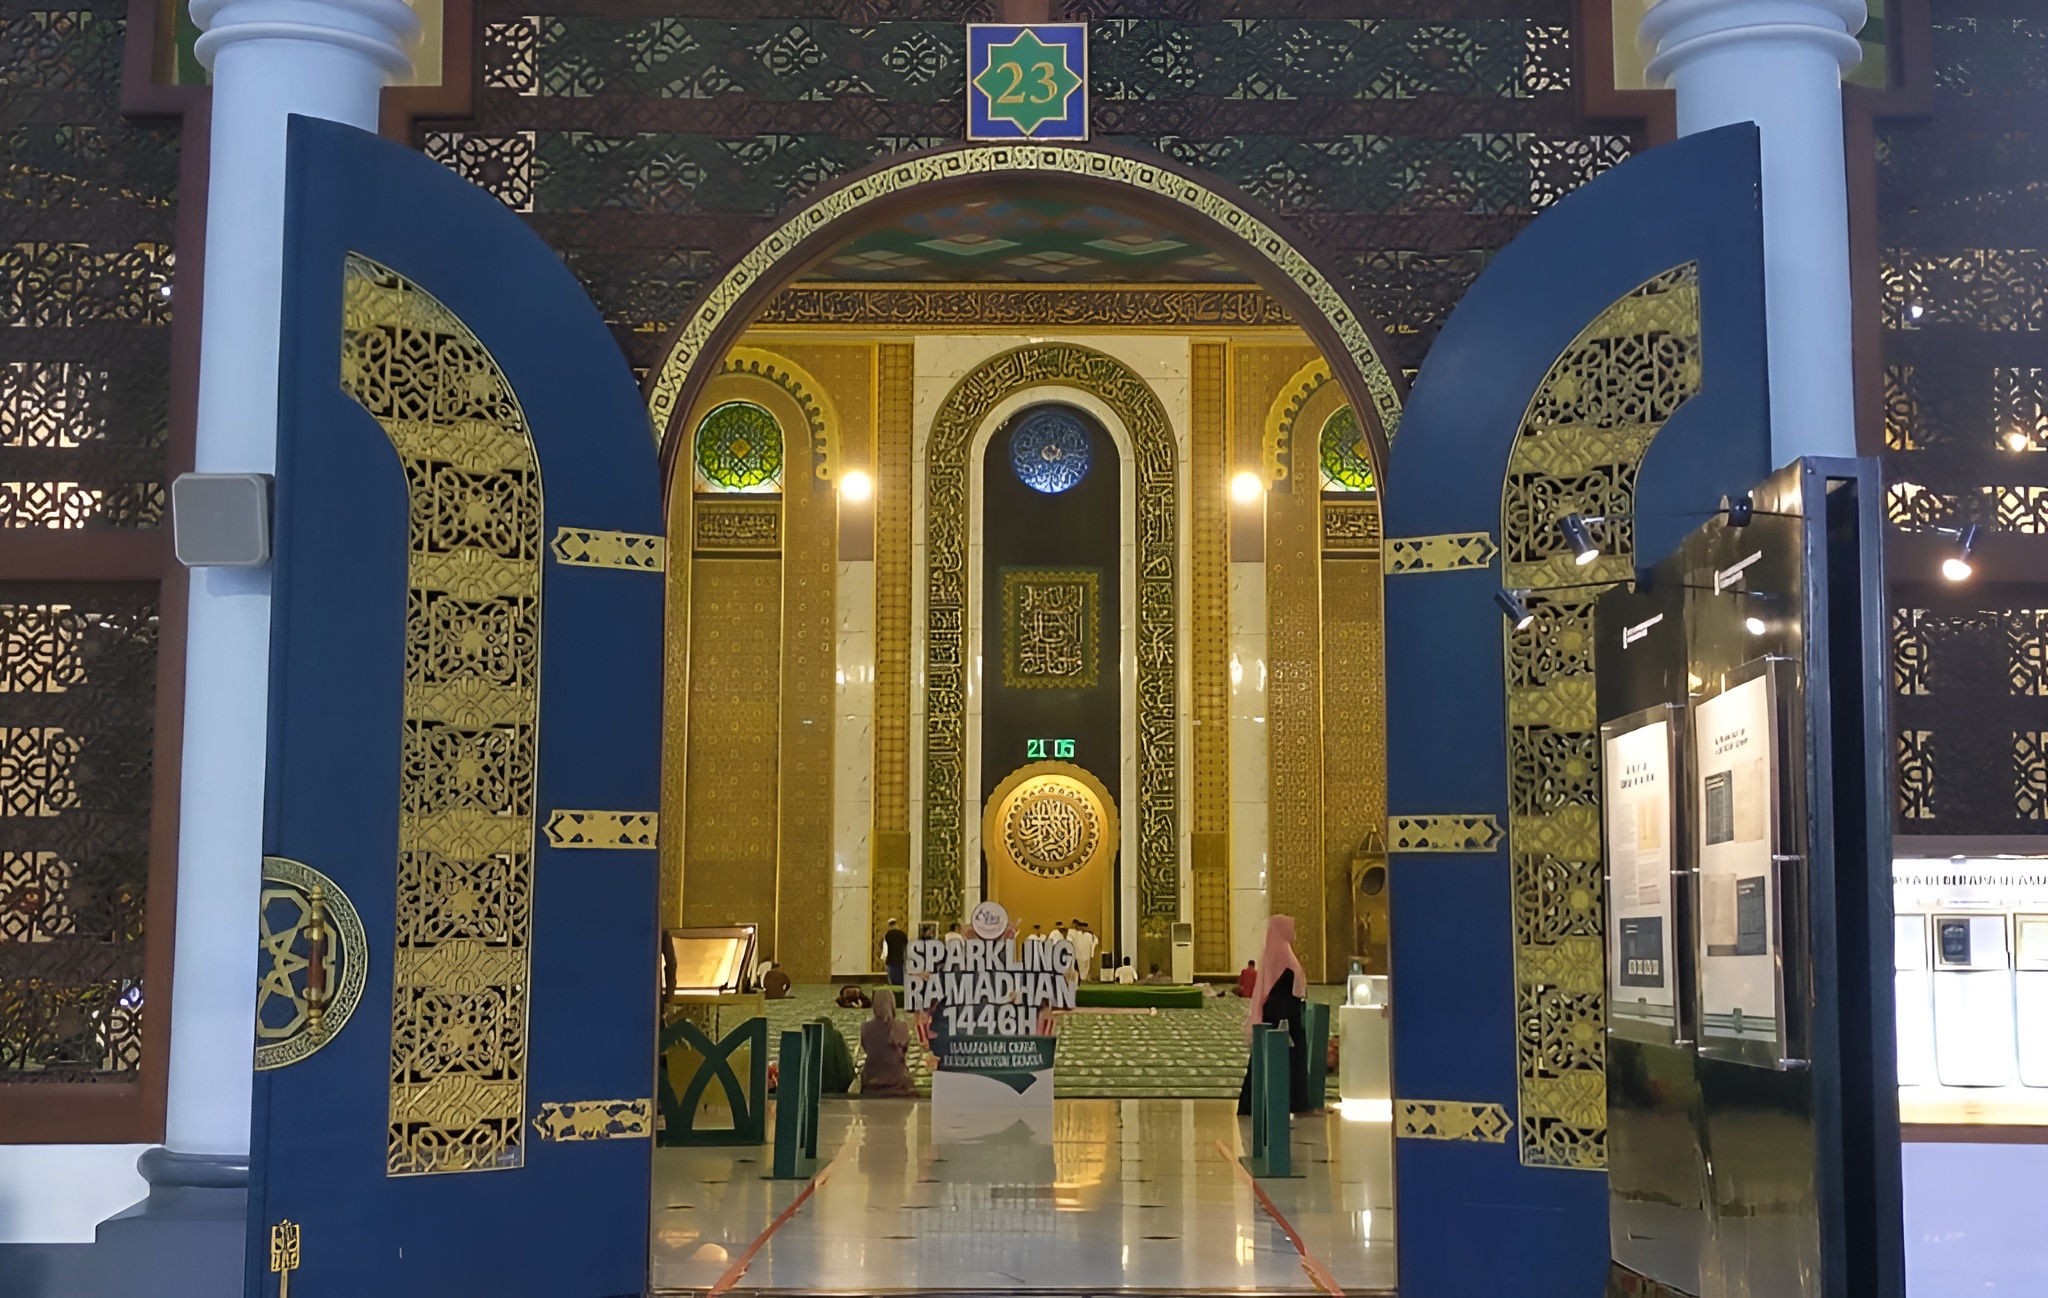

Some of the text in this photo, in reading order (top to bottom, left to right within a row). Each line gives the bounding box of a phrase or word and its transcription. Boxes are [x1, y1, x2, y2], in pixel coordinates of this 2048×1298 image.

[996, 61, 1058, 104] 23
[906, 938, 1076, 974] SPARKLING
[904, 971, 1077, 1011] RAMADHAN
[943, 1004, 1038, 1037] 1446H
